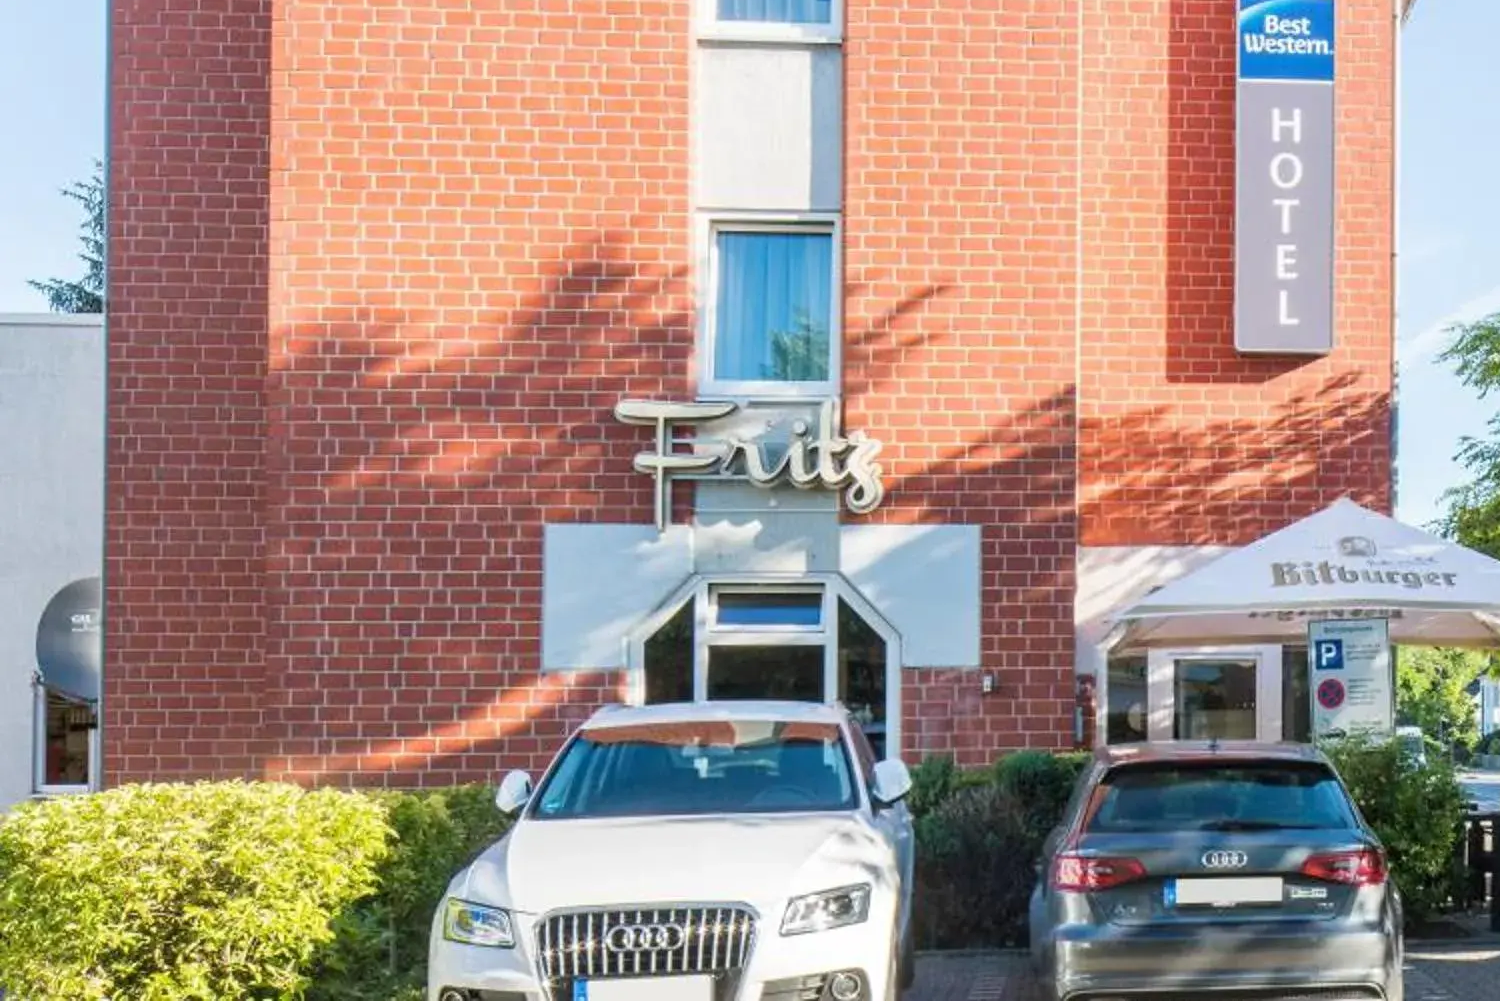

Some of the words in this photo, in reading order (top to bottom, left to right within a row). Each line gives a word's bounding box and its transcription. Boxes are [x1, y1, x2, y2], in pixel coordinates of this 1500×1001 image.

[1264, 14, 1311, 35] Best
[1269, 107, 1304, 327] HOTEL
[613, 399, 885, 531] Fritz
[1270, 559, 1458, 589] Bitburger
[1321, 642, 1337, 667] P
